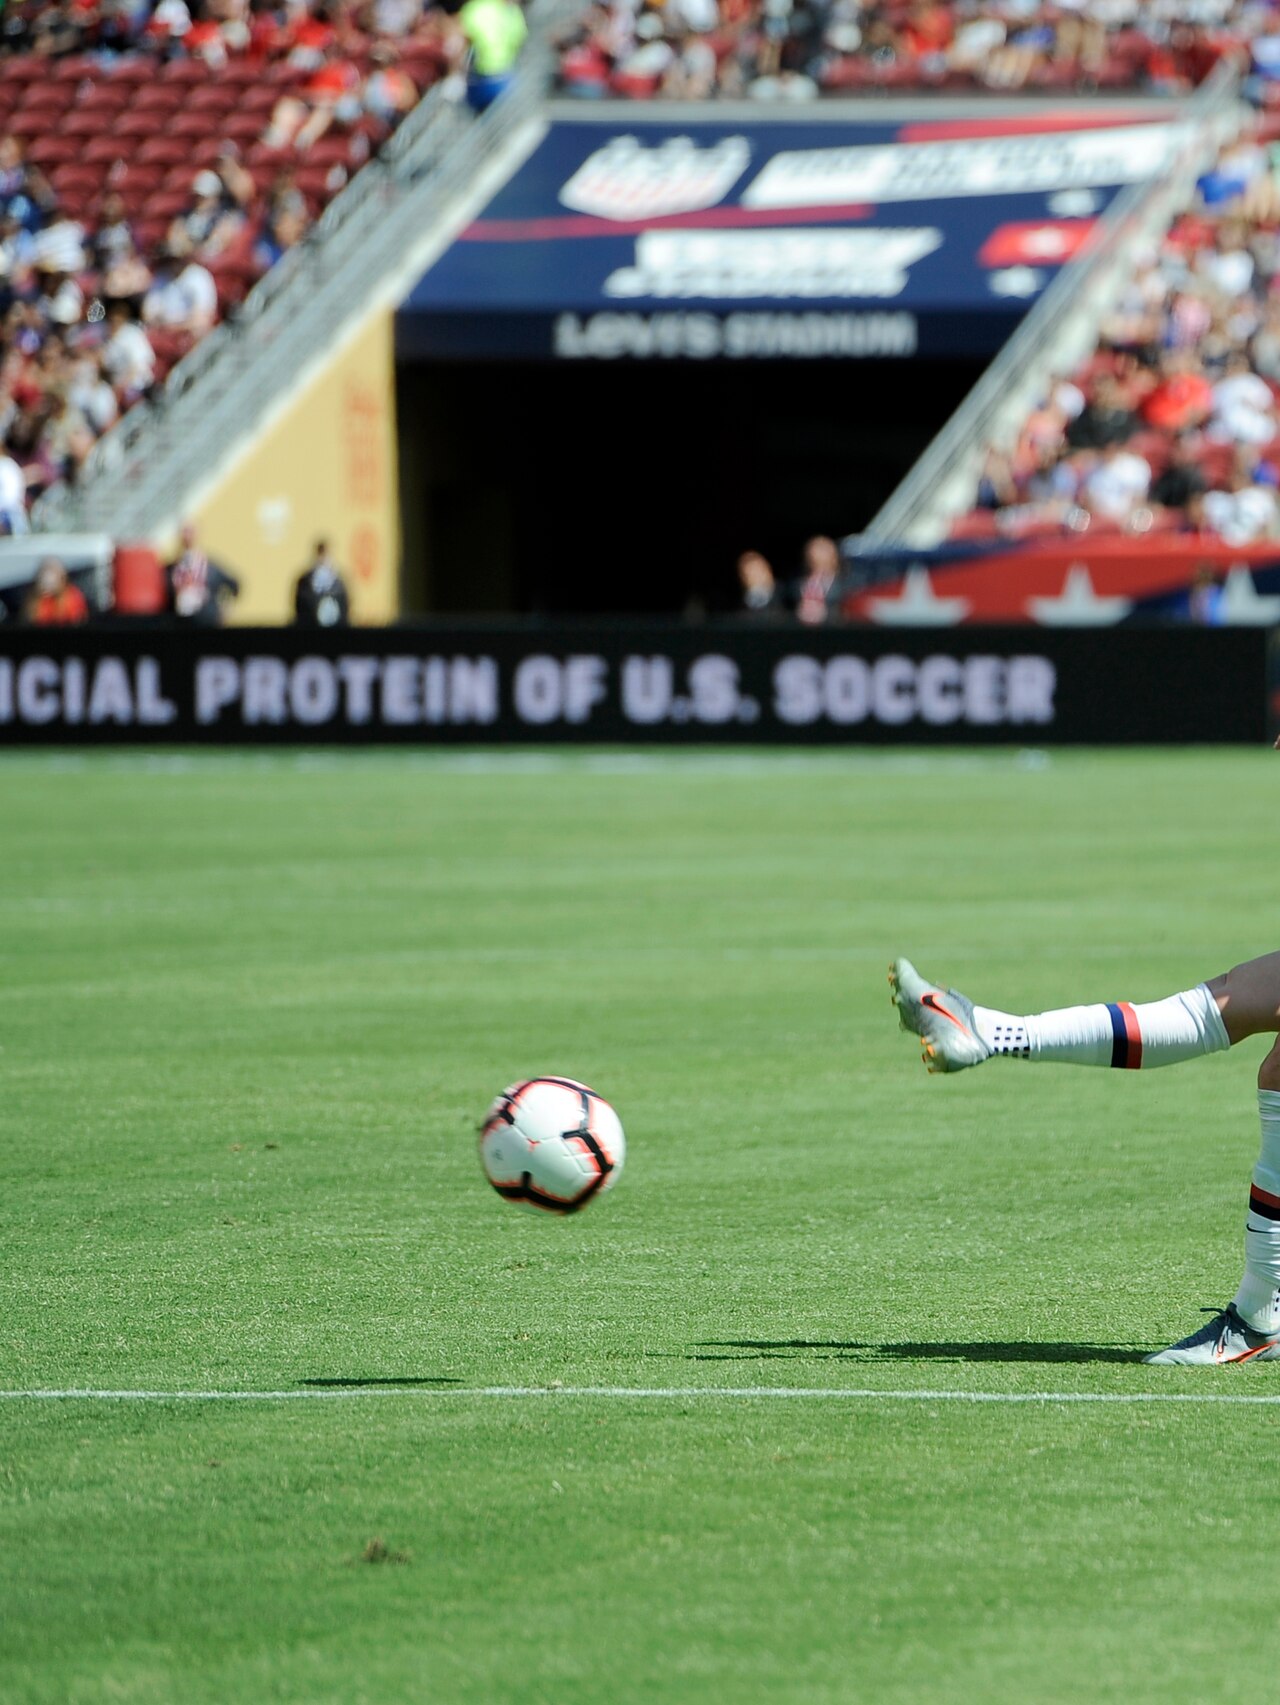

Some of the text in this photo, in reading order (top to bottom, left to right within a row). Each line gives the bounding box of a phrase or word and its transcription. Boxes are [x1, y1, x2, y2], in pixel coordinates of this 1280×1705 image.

[724, 311, 917, 358] STADIUM
[196, 655, 498, 724] PROTEIN
[514, 655, 605, 724] OF
[622, 655, 759, 724] U.S.
[775, 655, 1056, 724] SOCCER
